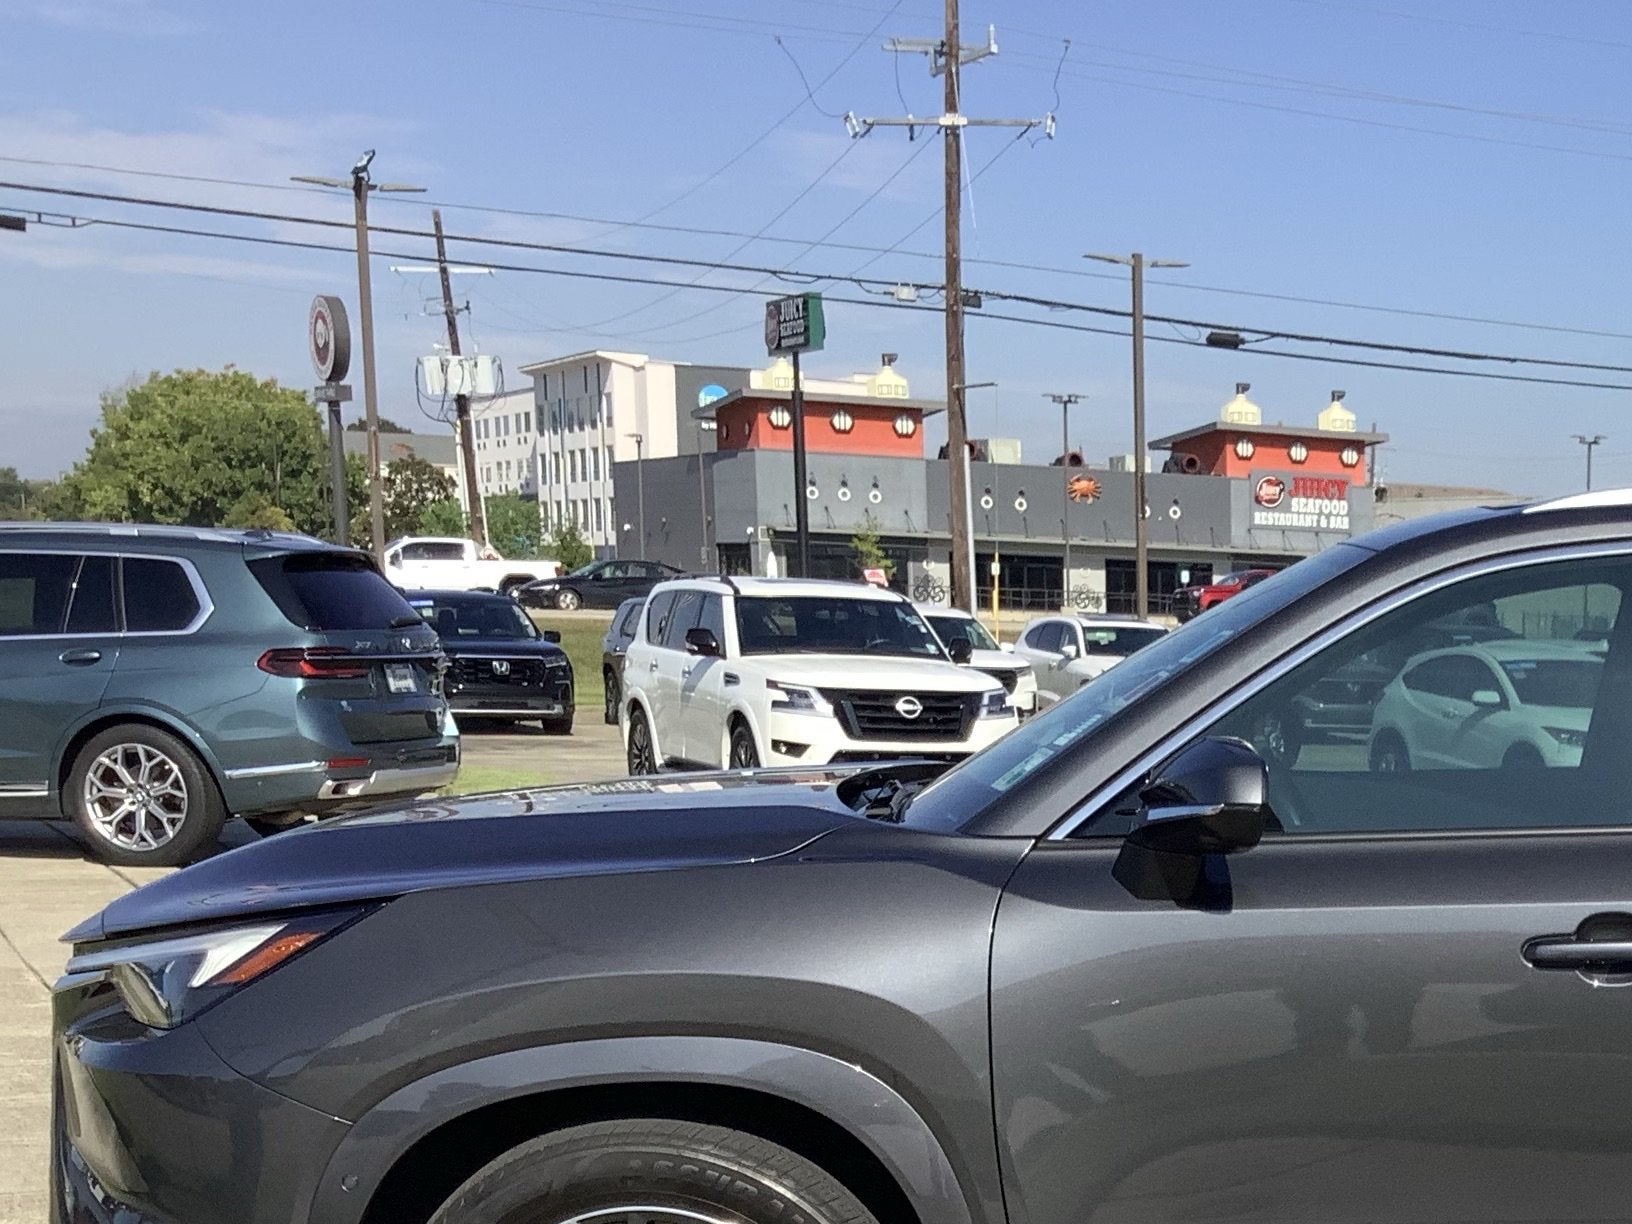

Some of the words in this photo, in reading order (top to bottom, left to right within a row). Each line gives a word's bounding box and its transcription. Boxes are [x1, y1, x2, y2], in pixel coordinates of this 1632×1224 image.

[780, 297, 804, 322] JUICY
[780, 319, 805, 337] SEAFOOD
[1289, 476, 1348, 499] JUICY
[1291, 497, 1348, 515] SEAFOOD
[1254, 511, 1318, 528] RESTAURANT
[1320, 515, 1328, 527] &
[1329, 515, 1349, 529] BAR
[355, 641, 371, 649] X7
